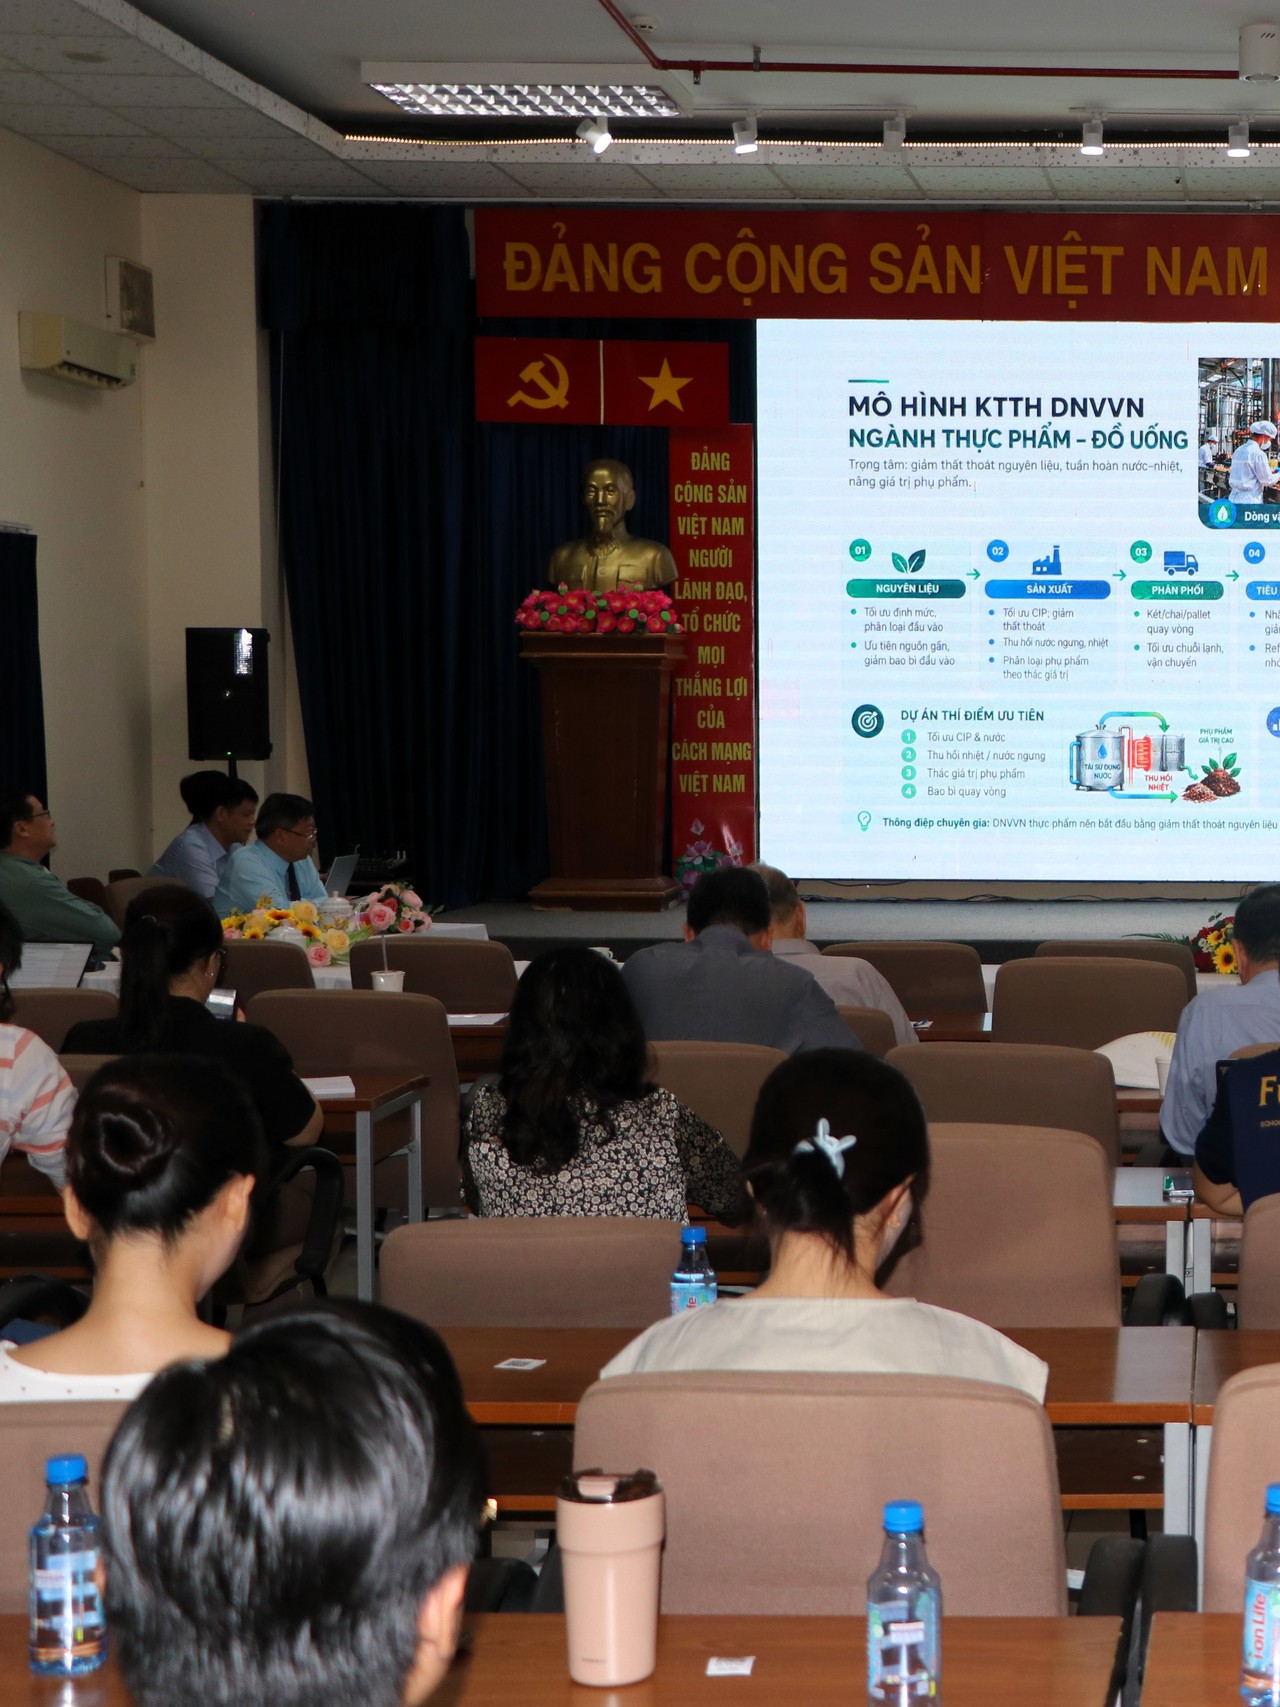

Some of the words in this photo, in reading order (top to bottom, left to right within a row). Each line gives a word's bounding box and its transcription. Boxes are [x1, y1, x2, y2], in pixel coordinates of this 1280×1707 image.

[503, 222, 663, 294] ĐẢNG
[684, 227, 847, 306] CỘNG
[869, 224, 980, 294] SẢN
[1004, 231, 1124, 308] VIỆT
[1147, 246, 1267, 296] NAM
[849, 391, 892, 416] MÔ
[901, 392, 966, 416] HÌNH
[976, 397, 1041, 417] KTTH
[1052, 397, 1143, 417] DNVVN
[850, 424, 935, 448] NGÀNH
[942, 428, 1002, 453] THỰC
[1009, 422, 1070, 448] PHẨM
[1091, 423, 1124, 449] ĐỒ
[1131, 423, 1188, 449] UỐNG
[690, 445, 731, 471] ĐẢNG
[849, 459, 879, 472] Trọng
[883, 460, 907, 469] tâm:
[911, 459, 937, 472] giảm
[941, 459, 962, 469] thất
[967, 460, 994, 470] thoát
[999, 460, 1037, 472] nguyên
[1041, 460, 1062, 472] liệu,
[1066, 460, 1089, 471] tuần
[1093, 461, 1118, 471] hoàn
[674, 480, 714, 507] CỘNG
[717, 478, 747, 504] SẢN
[849, 476, 875, 489] nâng
[879, 476, 895, 489] giá
[899, 477, 910, 488] trị
[914, 477, 934, 489] phụ
[938, 475, 971, 488] phẩm.
[677, 512, 708, 540] VIỆT
[711, 516, 745, 536] NAM
[689, 544, 733, 568] NGƯỜI
[854, 546, 867, 556] 01
[991, 546, 1004, 556] 02
[1135, 547, 1147, 557] 03
[1248, 549, 1260, 558] 04
[674, 577, 712, 600] LÃNH
[715, 581, 748, 605] ĐẠO,
[875, 582, 917, 594] NGUYÊN
[918, 583, 940, 597] LIỆU
[1026, 582, 1046, 594] SẢN
[1048, 581, 1074, 595] XUẤT
[1151, 585, 1179, 596] PHÂN
[1180, 583, 1205, 596] PHỐI
[1256, 584, 1278, 596] TIÊU
[683, 606, 700, 633] TỔ
[703, 611, 741, 633] CHỨC
[1147, 610, 1210, 620] Két/chai/pallet
[697, 645, 725, 669] MỌI
[676, 674, 722, 697] THẮNG
[725, 676, 748, 701] LỢI
[697, 703, 726, 729] CỦA
[902, 710, 918, 722] DỰ
[922, 708, 937, 720] ÁN
[942, 708, 960, 720] THÍ
[964, 707, 993, 720] ĐIỂM
[998, 711, 1014, 720] ƯU
[1018, 708, 1043, 721] TIÊN
[672, 742, 708, 761] CÁCH
[711, 741, 752, 765] MẠNG
[679, 770, 709, 793] VIỆT
[712, 774, 746, 793] NAM
[883, 818, 911, 828] Thông
[914, 818, 934, 828] điệp
[937, 818, 970, 829] chuyên
[973, 821, 989, 829] gia:
[1252, 1593, 1266, 1625] Life
